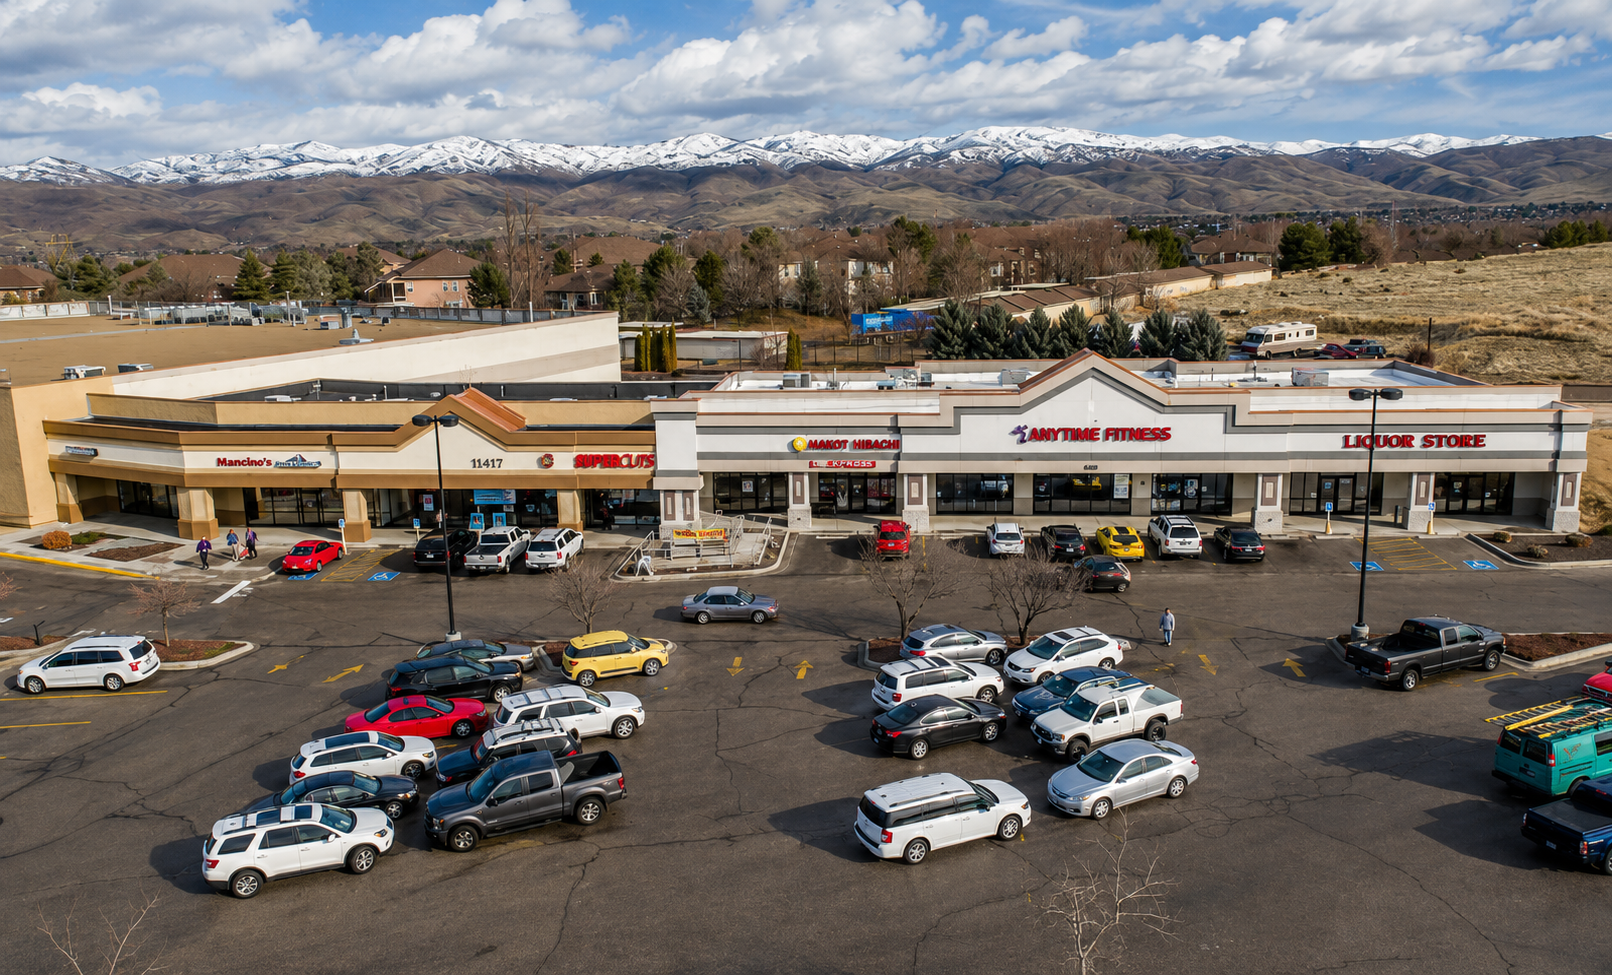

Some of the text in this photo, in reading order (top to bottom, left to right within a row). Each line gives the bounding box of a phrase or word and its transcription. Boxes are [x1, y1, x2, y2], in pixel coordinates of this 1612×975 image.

[1028, 427, 1172, 442] ANYTIME FITNESS
[852, 439, 901, 450] HIBACHI
[1342, 434, 1487, 449] LIQUOR STORE
[216, 457, 272, 467] Mancino's
[471, 458, 503, 469] 11417
[574, 453, 655, 469] SUPERCUTS
